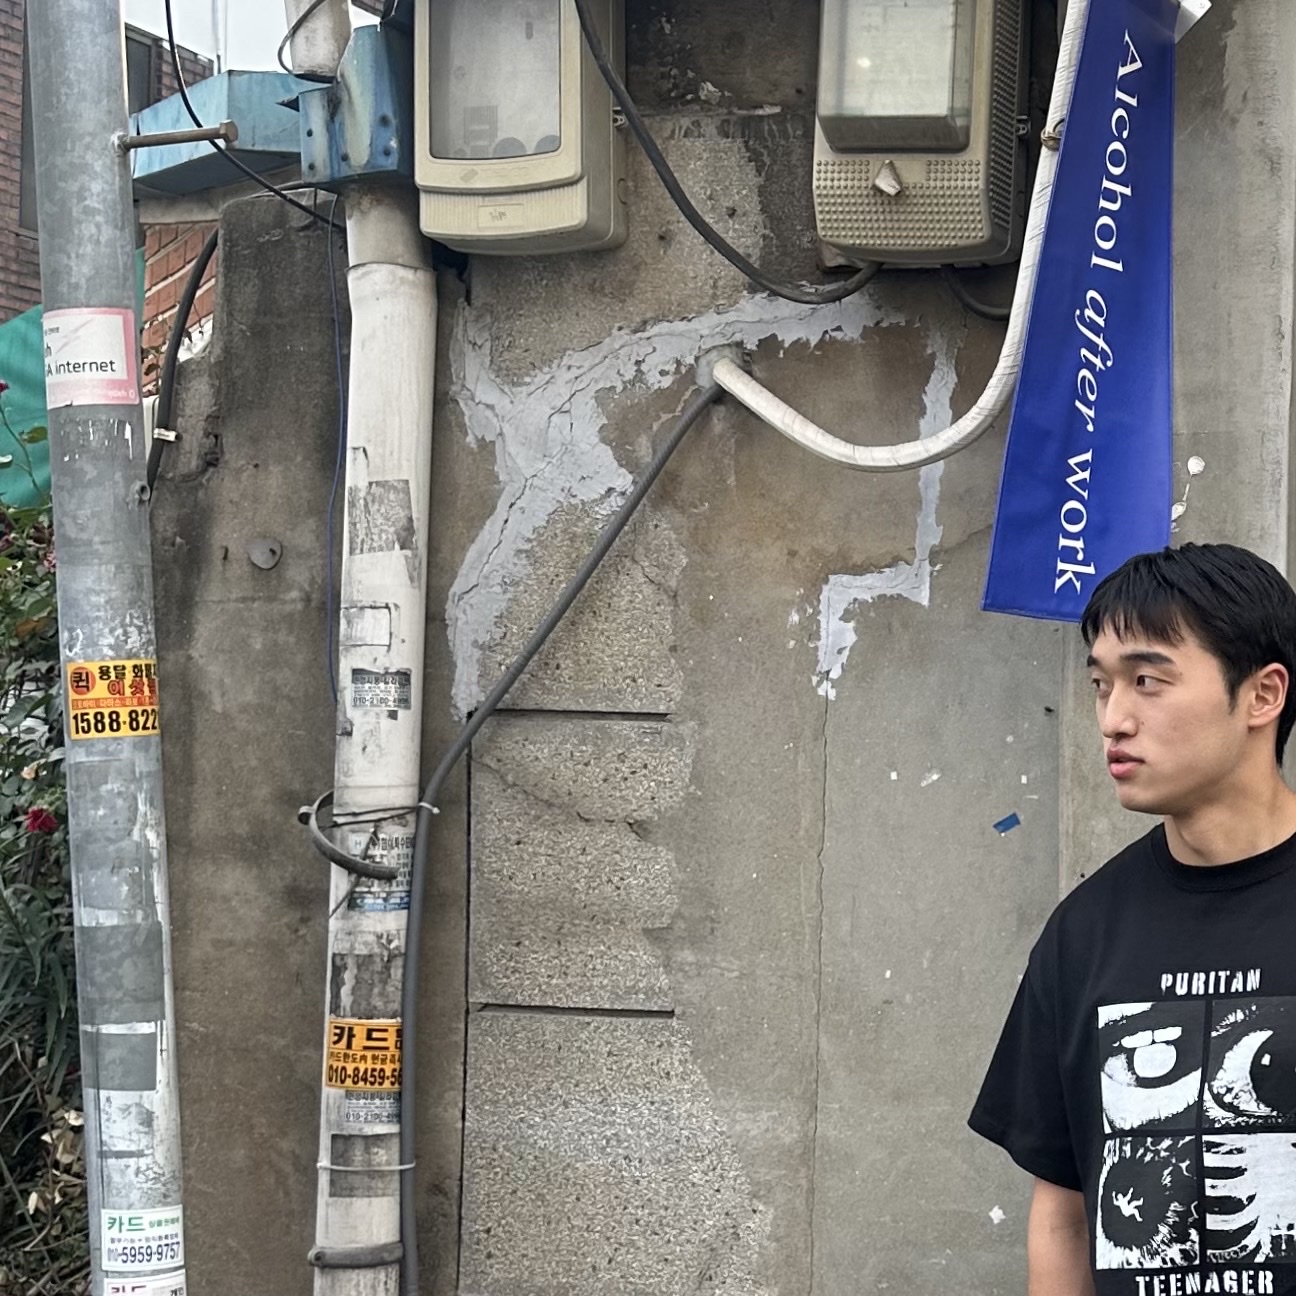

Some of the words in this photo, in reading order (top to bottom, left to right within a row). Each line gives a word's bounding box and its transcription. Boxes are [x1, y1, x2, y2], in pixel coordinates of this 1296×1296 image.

[1090, 30, 1143, 273] Alcohol
[55, 359, 116, 374] internet
[1075, 289, 1116, 434] after
[1053, 448, 1096, 595] work
[73, 671, 90, 692] 퀵
[1160, 968, 1261, 996] PURITAN
[107, 1215, 146, 1233] 카드
